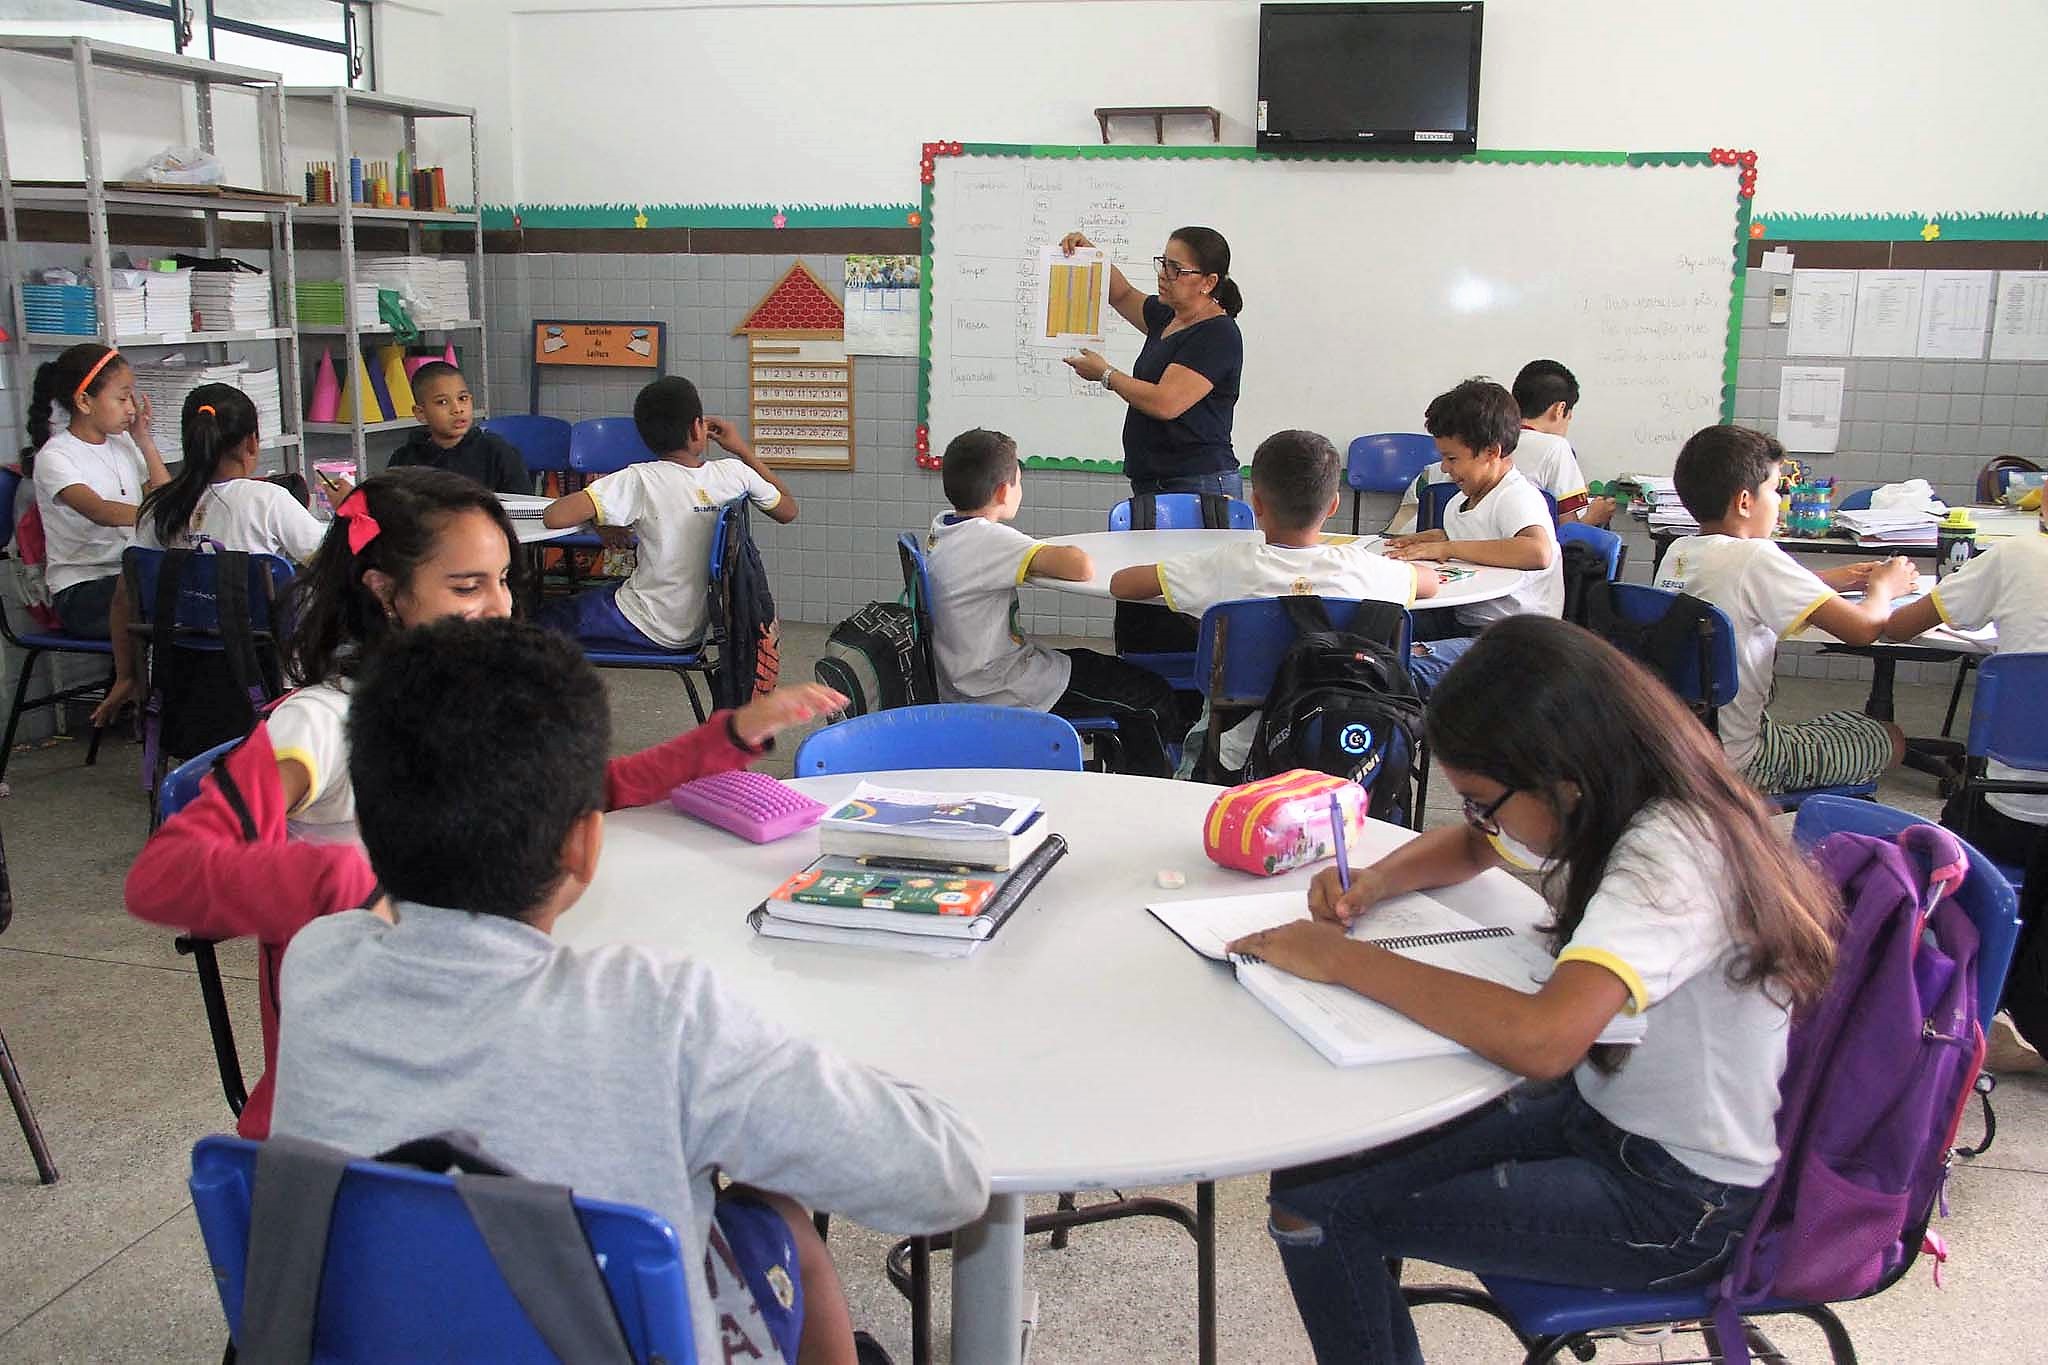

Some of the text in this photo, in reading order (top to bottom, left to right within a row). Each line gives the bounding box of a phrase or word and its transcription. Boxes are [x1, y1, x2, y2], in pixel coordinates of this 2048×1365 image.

[809, 390, 817, 398] 12
[761, 408, 770, 416] 15
[773, 408, 782, 416] 16
[785, 408, 793, 416] 17
[797, 409, 806, 417] 18
[809, 409, 818, 417] 19
[820, 409, 830, 417] 20
